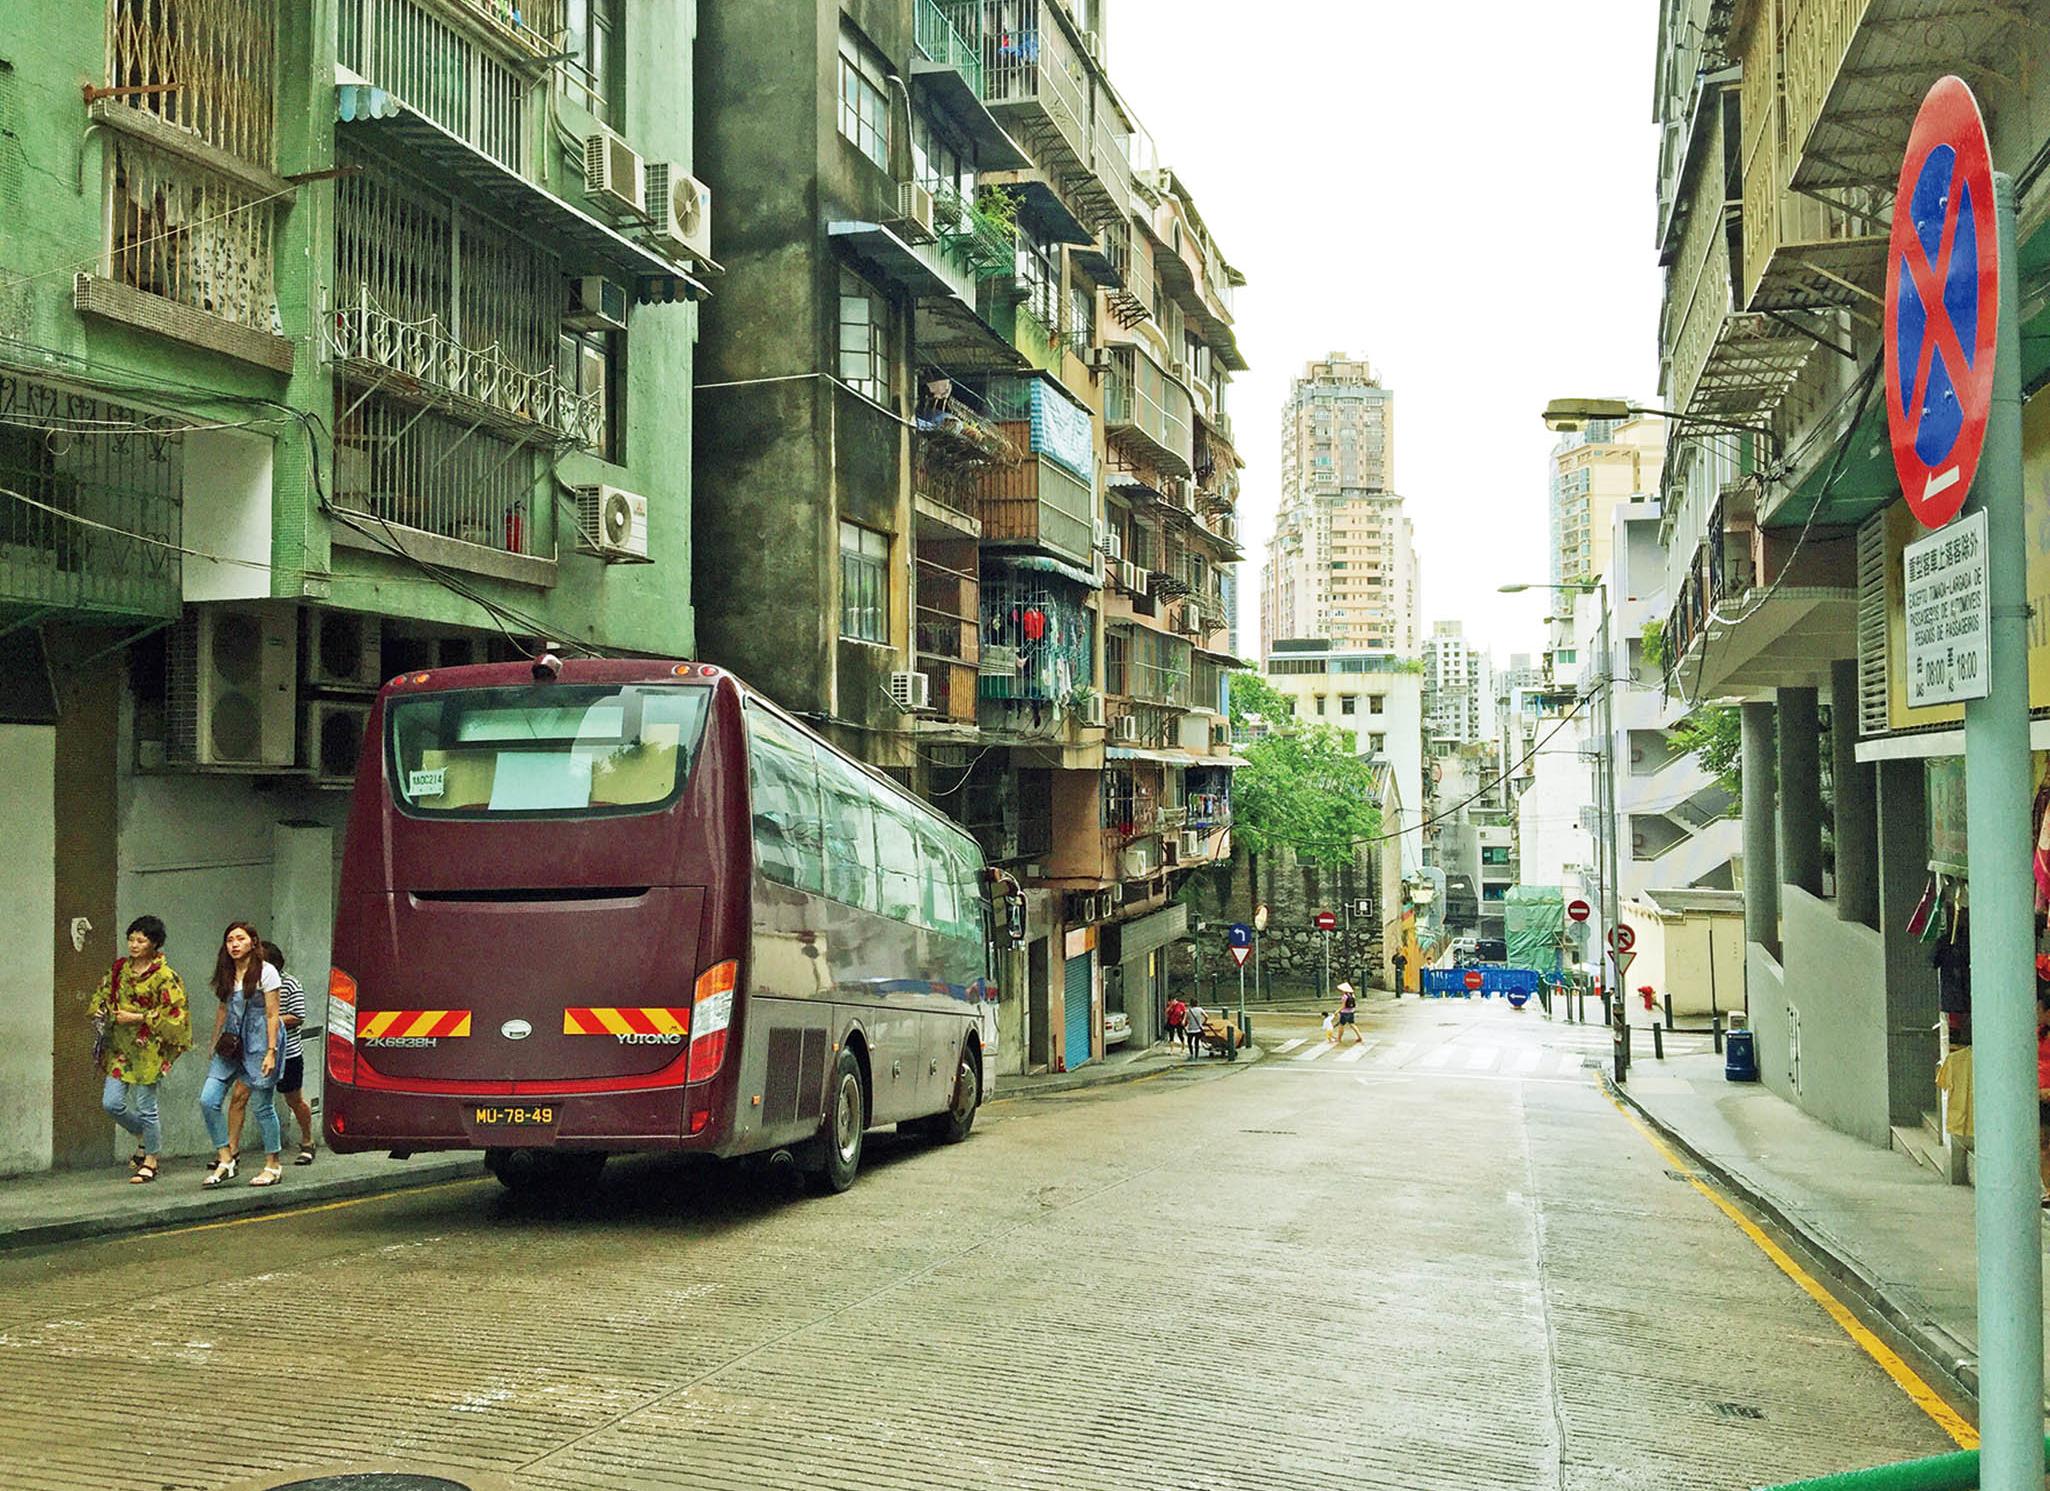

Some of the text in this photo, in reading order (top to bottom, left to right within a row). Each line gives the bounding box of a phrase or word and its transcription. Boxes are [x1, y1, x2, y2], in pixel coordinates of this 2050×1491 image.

[1909, 587, 1928, 609] EXCEPTO
[1974, 566, 1982, 586] DE
[1940, 601, 1948, 619] DE
[1915, 613, 1979, 647] PESADOS DE PASSAGEIROS
[1926, 659, 1945, 687] 08:00
[1956, 651, 1977, 681] 18:00
[365, 1037, 437, 1048] ZK6938H
[616, 1033, 682, 1045] YUTONG
[476, 1108, 552, 1123] MU-78-49
